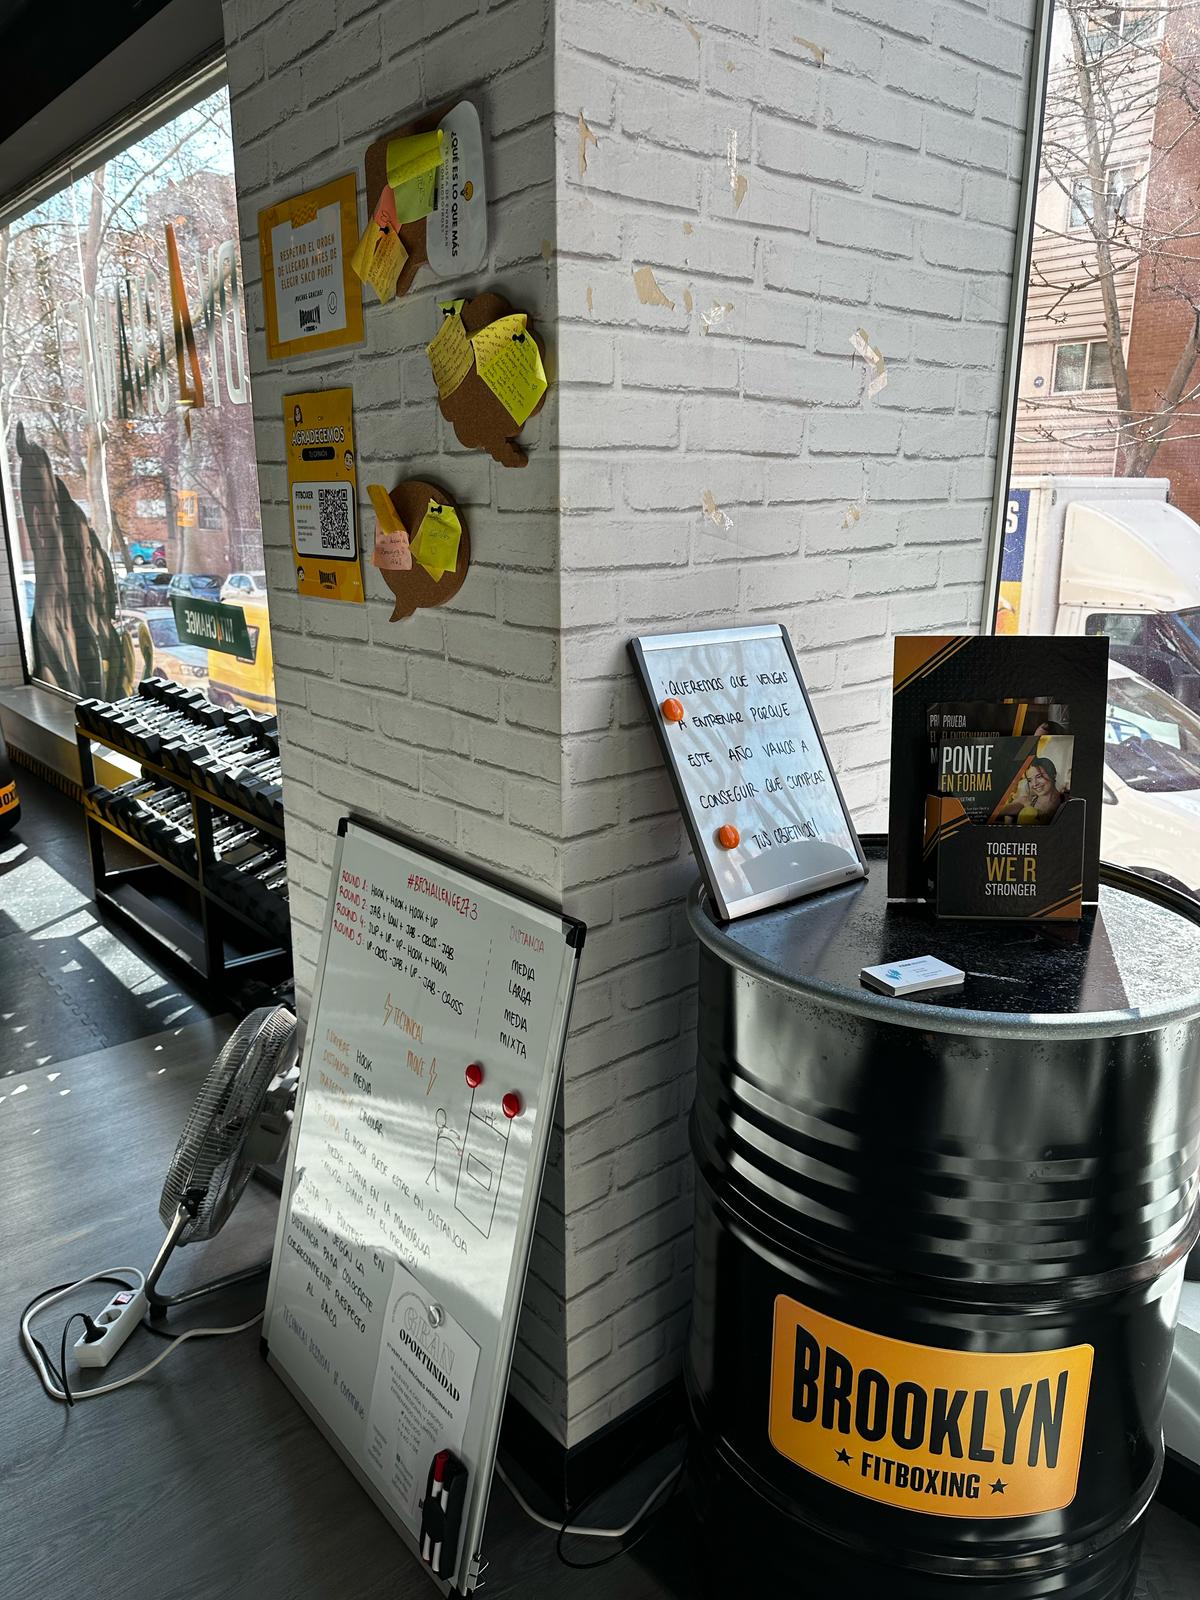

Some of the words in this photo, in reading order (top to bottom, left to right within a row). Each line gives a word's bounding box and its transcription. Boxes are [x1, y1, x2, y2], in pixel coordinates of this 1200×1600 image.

[451, 166, 459, 181] ES
[451, 184, 459, 200] LO
[451, 202, 459, 228] QUE
[307, 241, 316, 253] EL
[451, 230, 460, 257] MÁS
[292, 426, 345, 446] AGRADECEMOS
[729, 674, 749, 689] QUE
[756, 672, 790, 686] VENGAS
[678, 718, 688, 731] A
[692, 711, 744, 729] ENTRENAR
[749, 702, 791, 723] PORQUE
[942, 714, 967, 728] PRUEBA
[687, 752, 714, 768] ESTE
[728, 744, 754, 764] AÑO
[762, 740, 797, 758] VAMOS
[801, 740, 810, 752] A
[942, 744, 994, 774] PONTE
[698, 781, 760, 810] CONSEGUIR
[765, 777, 782, 794] QUE
[941, 774, 954, 793] EN
[957, 774, 992, 792] FORMA
[752, 830, 772, 850] TUS
[986, 842, 1038, 856] TOGETHER
[986, 856, 1016, 882] WE
[1023, 857, 1037, 882] R
[342, 870, 360, 889] ROUND
[370, 884, 384, 900] HOOK
[390, 895, 404, 910] HOOK
[408, 904, 424, 922] HOOK
[430, 916, 438, 928] UP
[984, 884, 1037, 896] STRONGER
[340, 885, 361, 907] ROUND
[369, 904, 382, 920] JAB
[406, 924, 416, 939] JAB
[336, 902, 358, 922] ROUND
[408, 945, 423, 963] HOOK
[334, 920, 354, 942] ROUND
[422, 976, 436, 996] JAB
[441, 990, 464, 1016] CROSS
[511, 959, 536, 982] MEDIA
[508, 980, 532, 1007] LARGA
[504, 1008, 528, 1033] MEDIA
[500, 1031, 527, 1060] MIXTA
[356, 1048, 373, 1072] HOOK
[352, 1072, 372, 1096] MEDIA
[322, 1246, 338, 1270] PARA
[373, 1252, 385, 1273] EN
[404, 1306, 456, 1378] GRAN
[399, 1328, 461, 1402] OPORTUNIDAD
[792, 1322, 1070, 1470] BROOKLYN
[860, 1451, 980, 1500] FITBOXING
